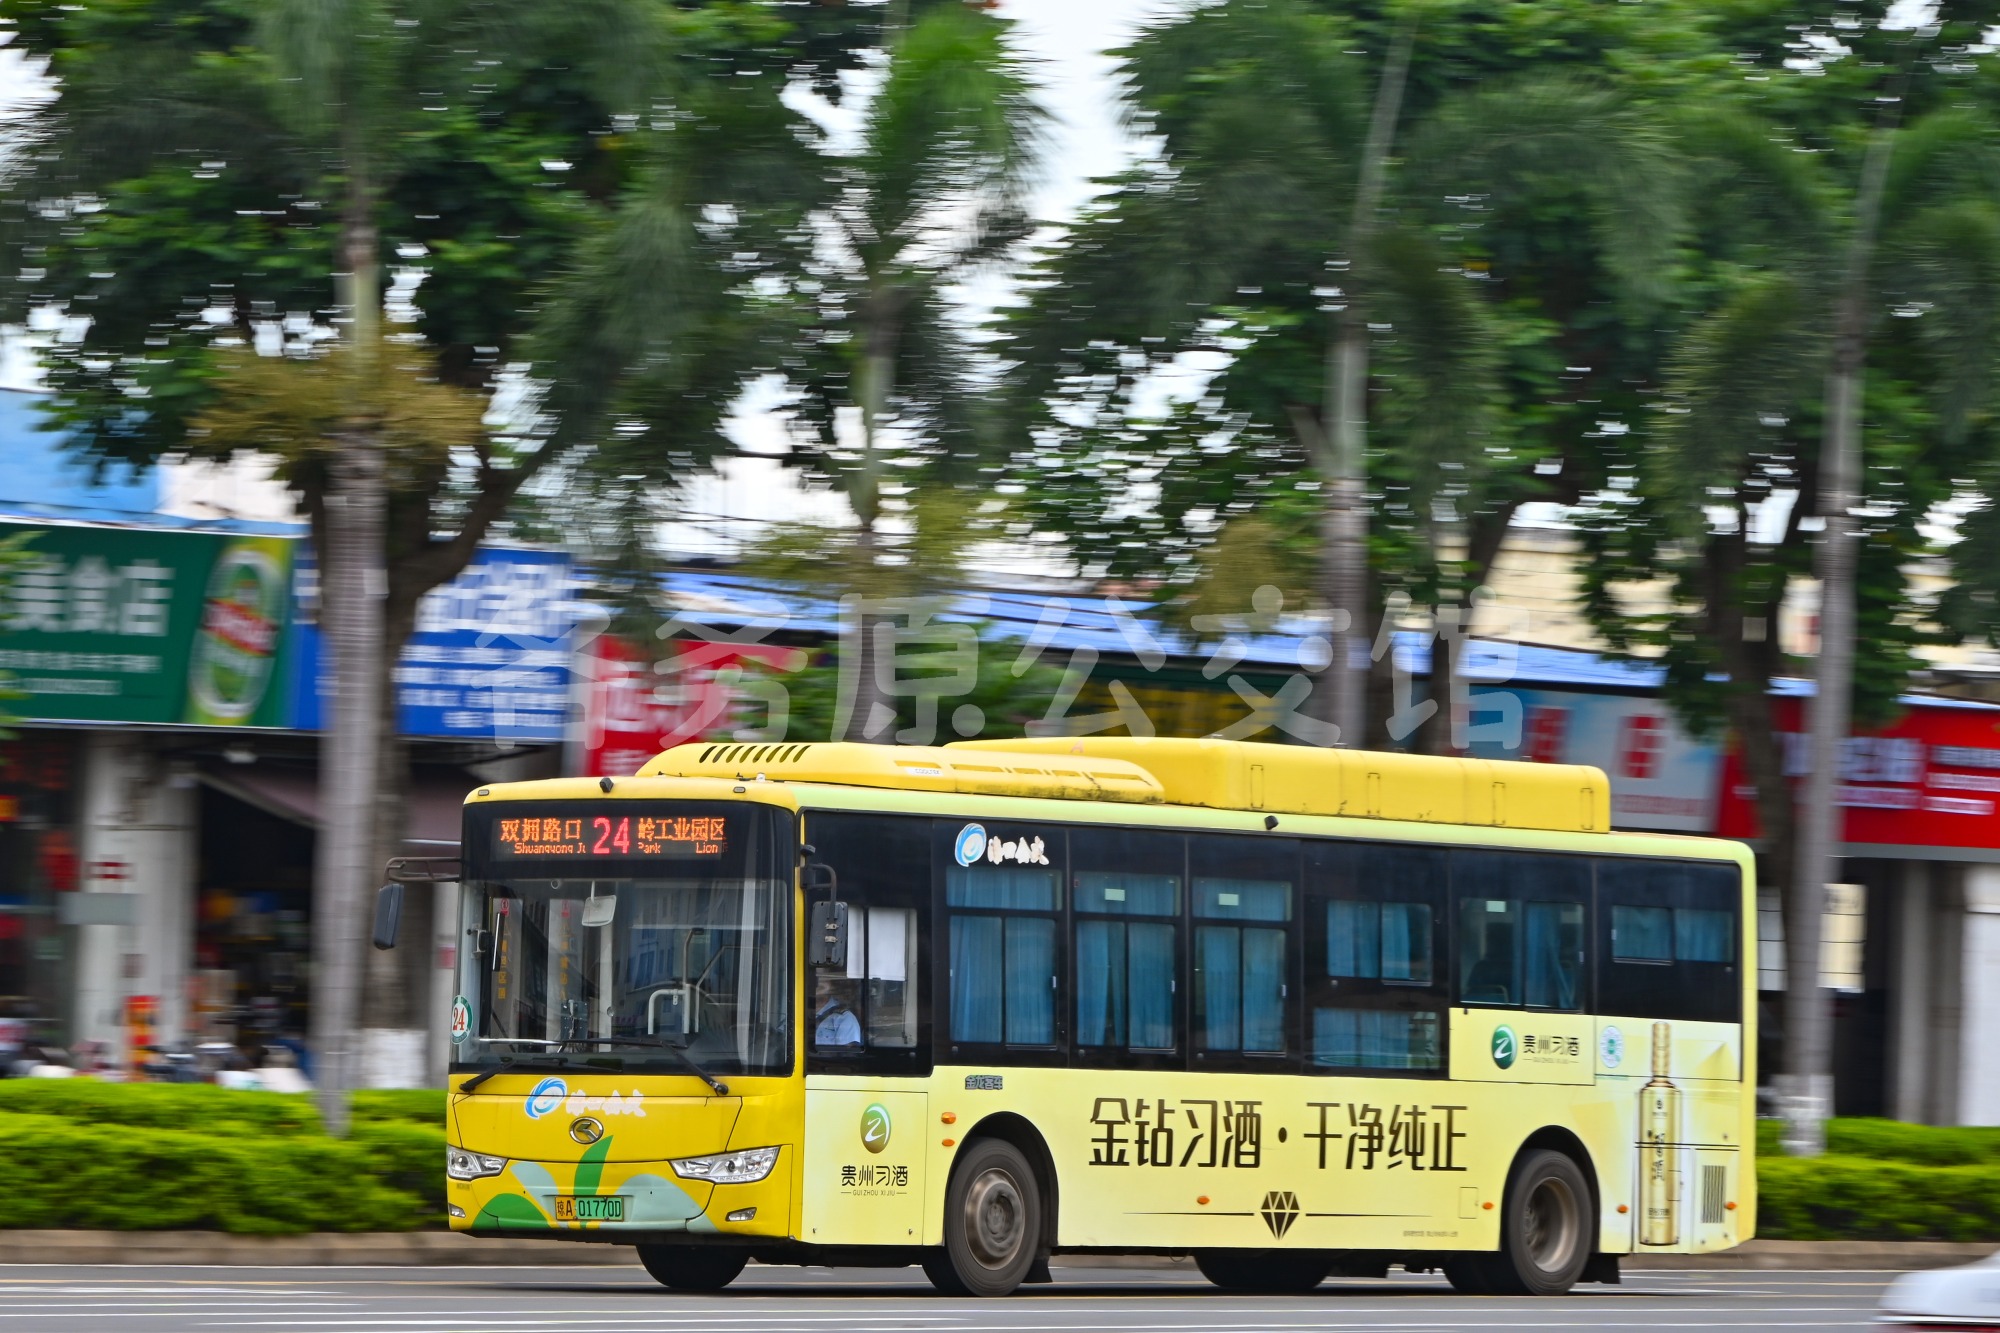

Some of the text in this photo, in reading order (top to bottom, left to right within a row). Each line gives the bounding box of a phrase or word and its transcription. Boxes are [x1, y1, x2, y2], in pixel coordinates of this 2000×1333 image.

[501, 818, 582, 842] 双拥路口
[593, 816, 630, 854] 24
[638, 817, 725, 841] 岭工业园区
[452, 1007, 465, 1031] 24
[1523, 1034, 1580, 1056] 贵州习酒
[964, 1075, 1003, 1090] 金龙客车
[841, 1165, 908, 1187] 贵州习酒
